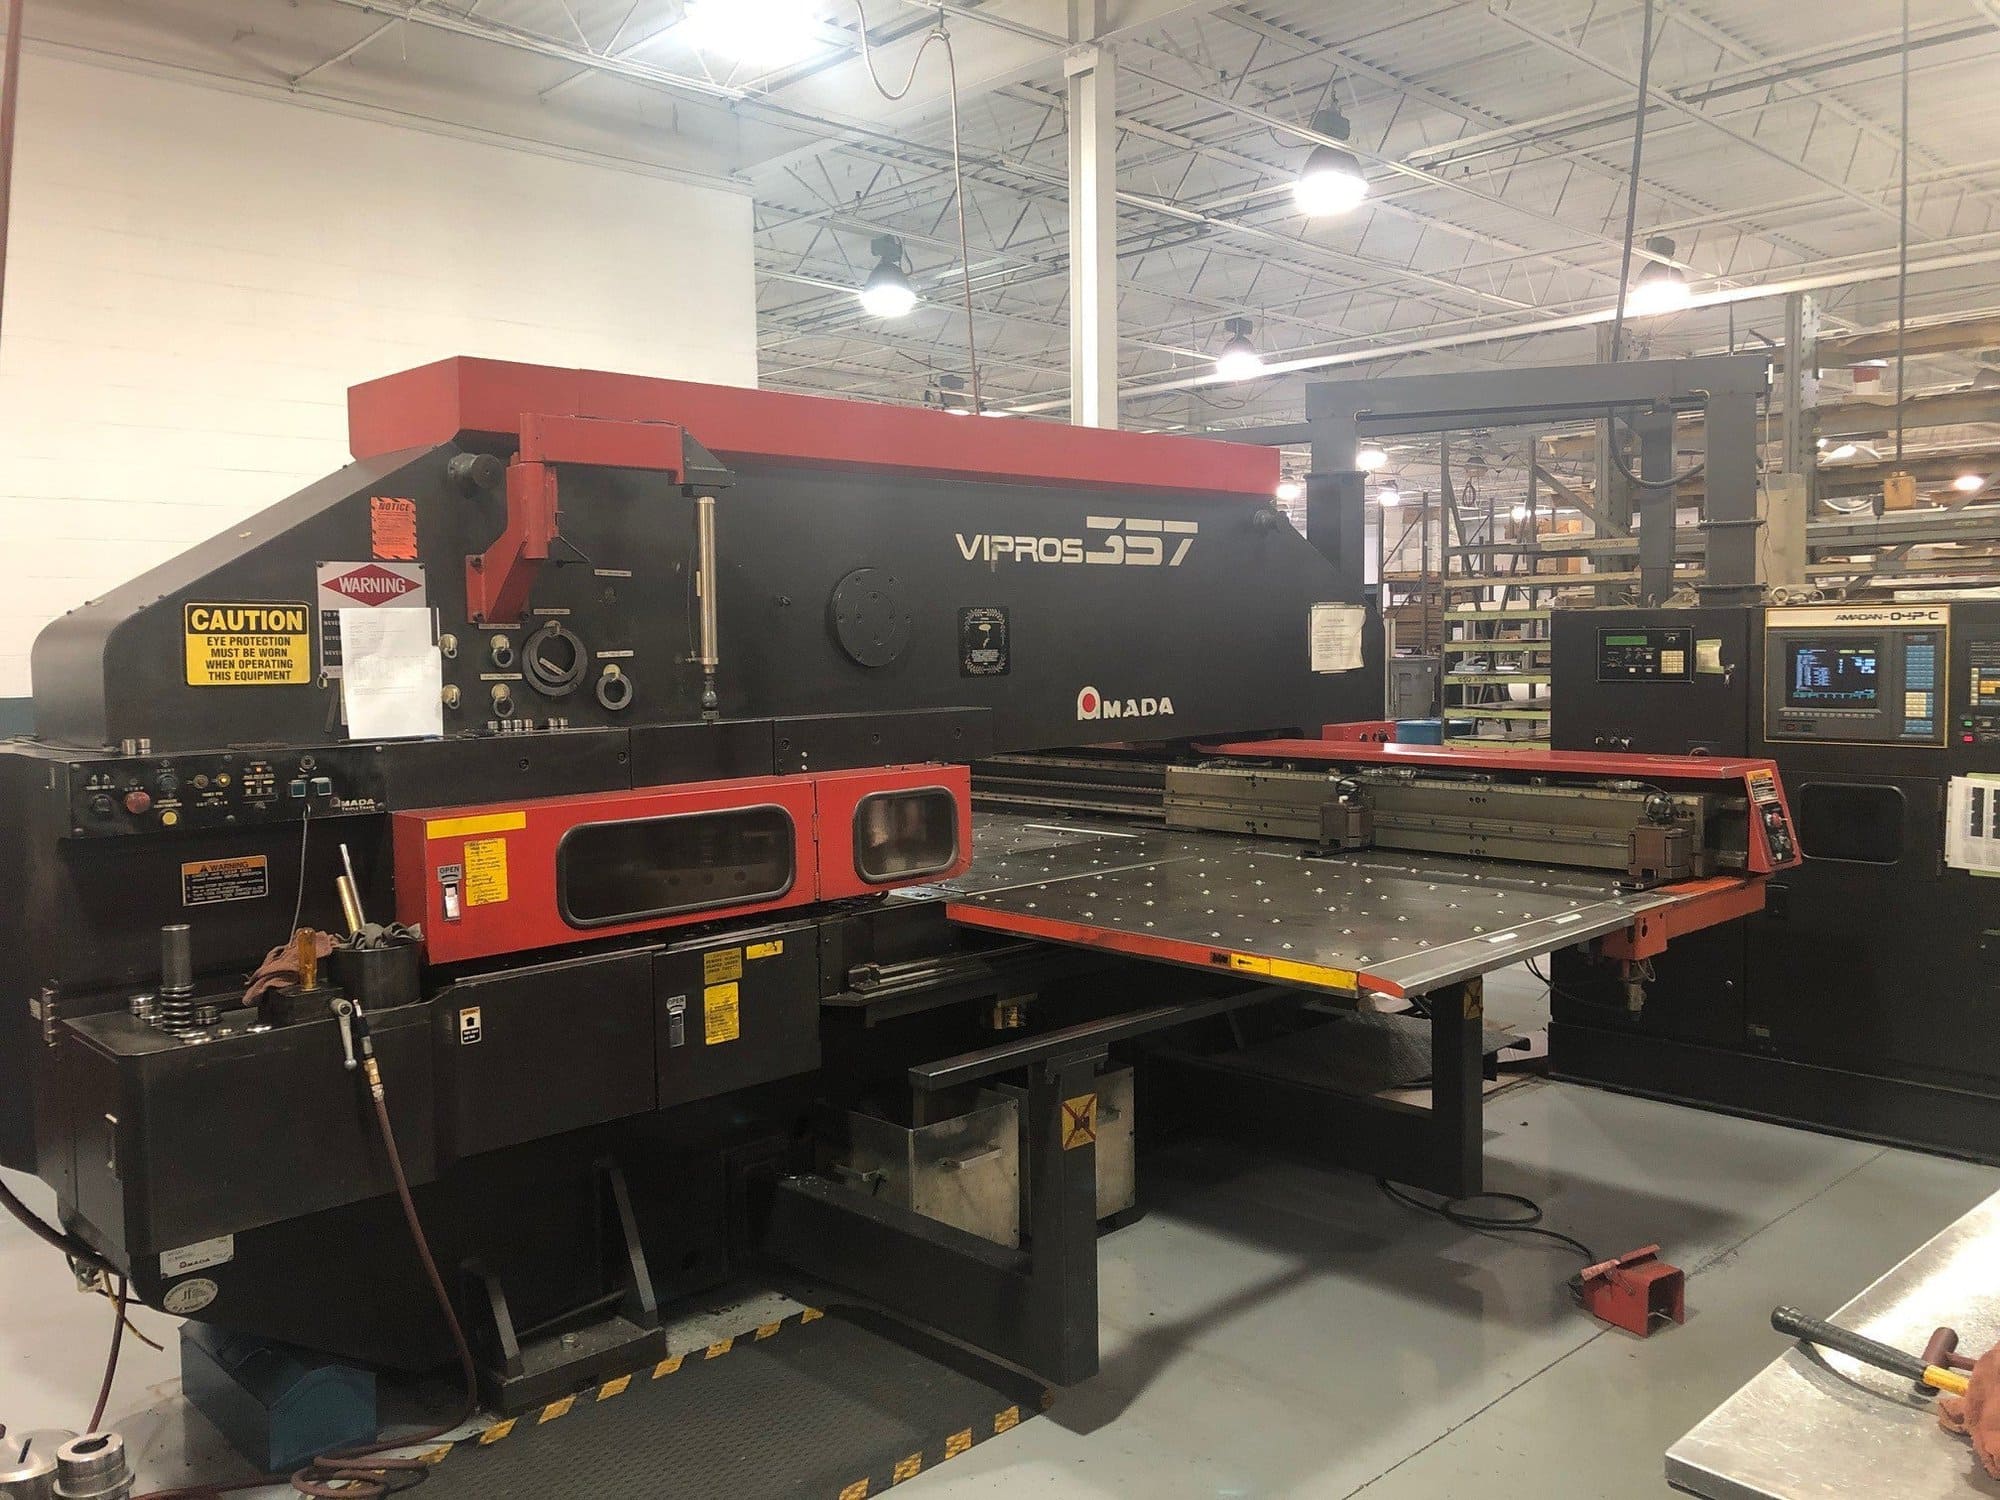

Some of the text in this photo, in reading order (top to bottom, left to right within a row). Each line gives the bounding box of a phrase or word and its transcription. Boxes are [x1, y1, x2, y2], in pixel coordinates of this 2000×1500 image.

[379, 502, 409, 511] NOTICE
[955, 516, 1198, 566] VIPROS 357
[339, 577, 406, 593] WARNING
[191, 609, 303, 631] CAUTION
[207, 636, 291, 646] EYE PROTECTION
[211, 648, 287, 657] MUST BE WORN
[206, 660, 293, 669] WHEN OPERATING
[209, 671, 292, 681] THIS EQUIPMENT
[1077, 686, 1174, 720] AMADA
[209, 861, 249, 872] WARNING
[440, 866, 460, 874] OPEN
[667, 997, 684, 1005] OPEN
